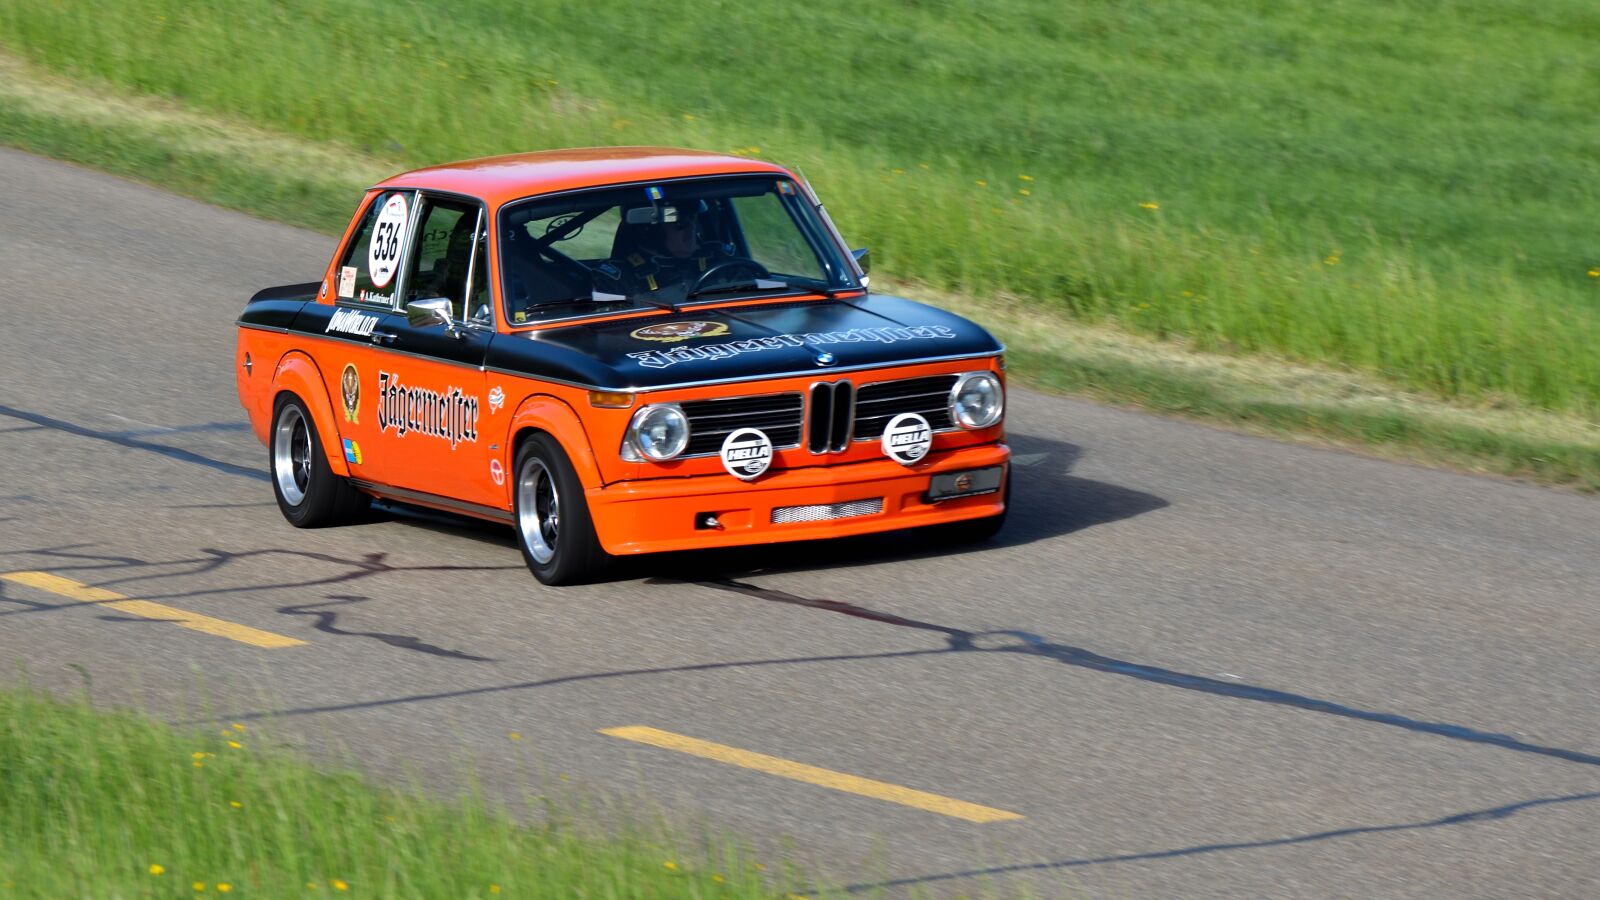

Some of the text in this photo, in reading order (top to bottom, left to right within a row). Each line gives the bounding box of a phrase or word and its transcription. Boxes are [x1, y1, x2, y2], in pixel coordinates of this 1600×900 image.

[374, 222, 401, 261] 536
[377, 370, 480, 450] Jägermeister
[891, 429, 929, 447] HELLA
[728, 445, 769, 462] HELLA
